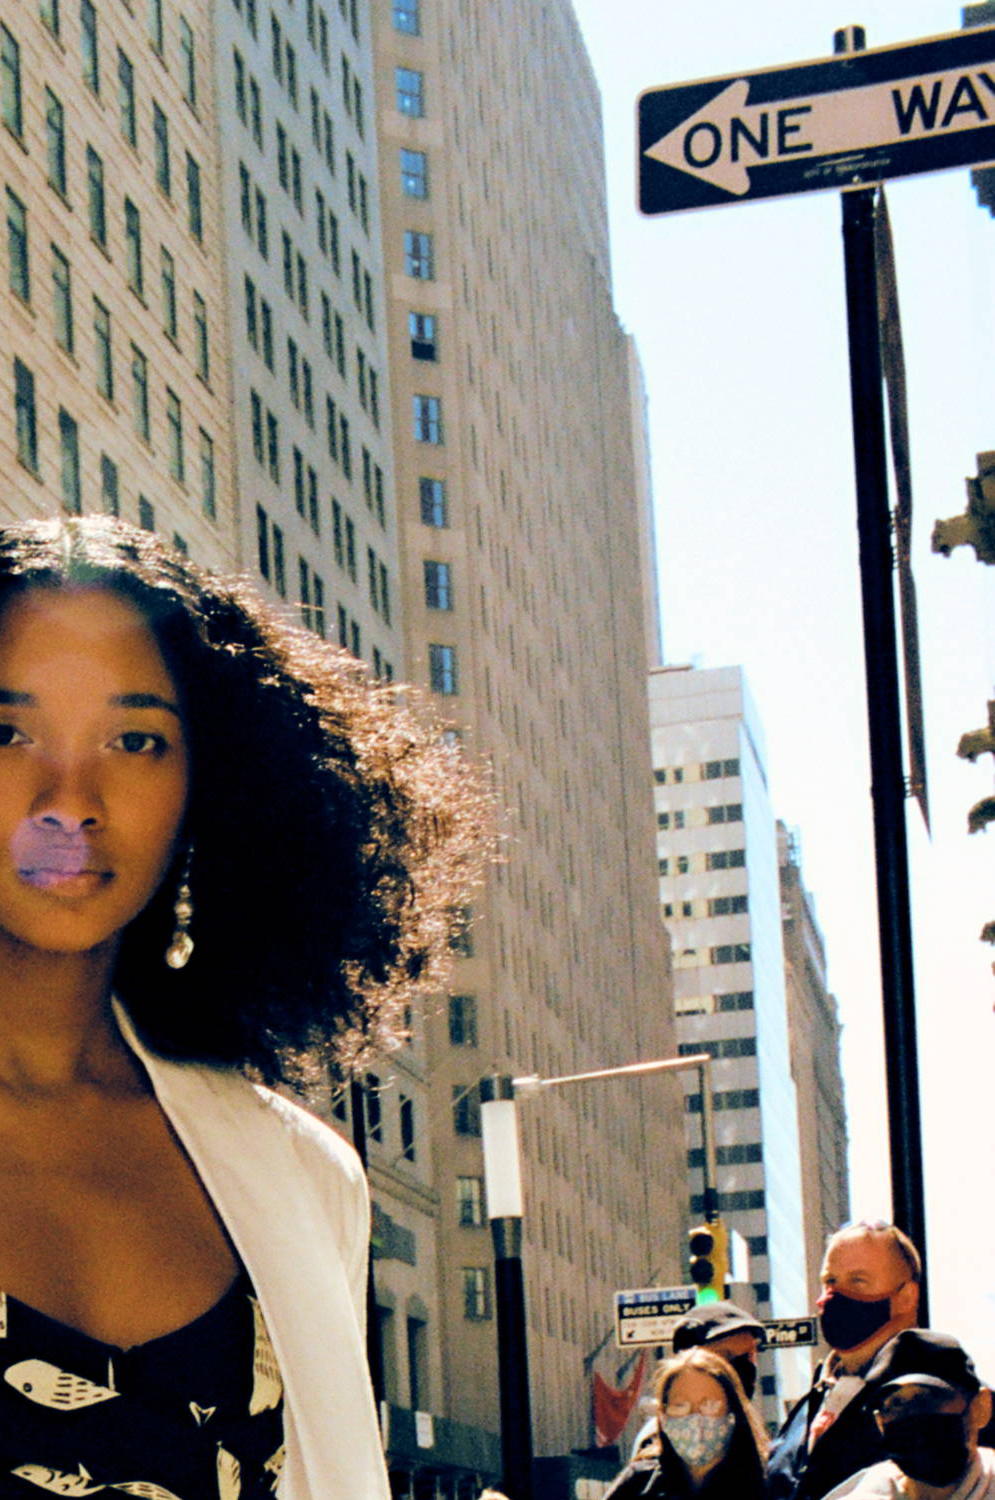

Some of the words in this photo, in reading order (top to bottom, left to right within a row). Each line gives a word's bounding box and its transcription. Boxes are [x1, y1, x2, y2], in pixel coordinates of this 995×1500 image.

[682, 105, 813, 169] ONE
[622, 1305, 659, 1317] BUSES
[662, 1302, 691, 1314] ONLY
[766, 1327, 798, 1344] Pine
